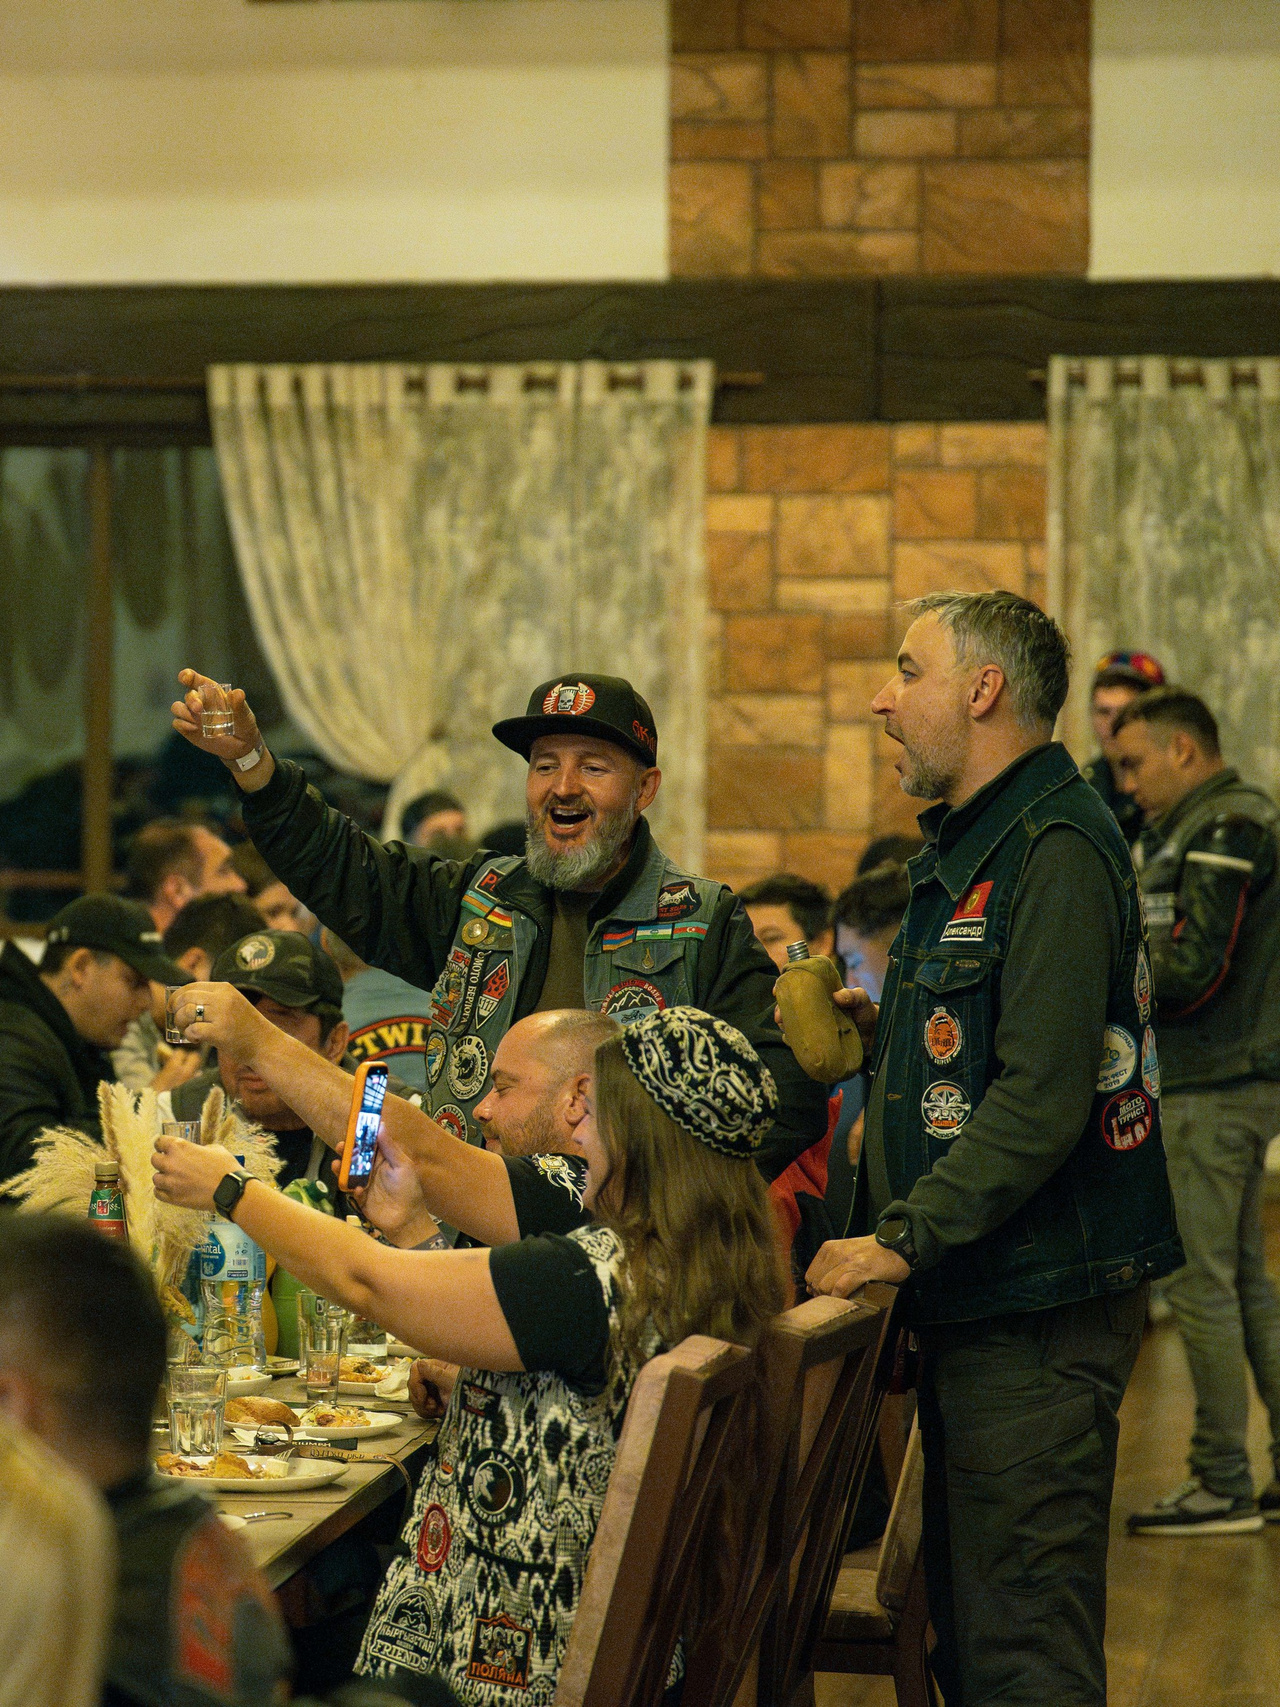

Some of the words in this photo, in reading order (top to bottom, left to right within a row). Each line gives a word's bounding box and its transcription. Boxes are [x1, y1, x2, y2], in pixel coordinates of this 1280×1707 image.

[945, 925, 984, 938] Александр
[468, 957, 485, 984] МОТО
[460, 984, 477, 1024] БЕРЛОГА
[351, 1022, 432, 1058] -TWI
[1117, 1105, 1146, 1125] ТУРИСТ
[1118, 1096, 1142, 1115] МОТО
[380, 1624, 436, 1655] КЫРГЫЗСТАН
[480, 1624, 527, 1646] МОТО
[374, 1641, 429, 1671] FRIENDS
[471, 1661, 524, 1686] ПОЛЯНА
